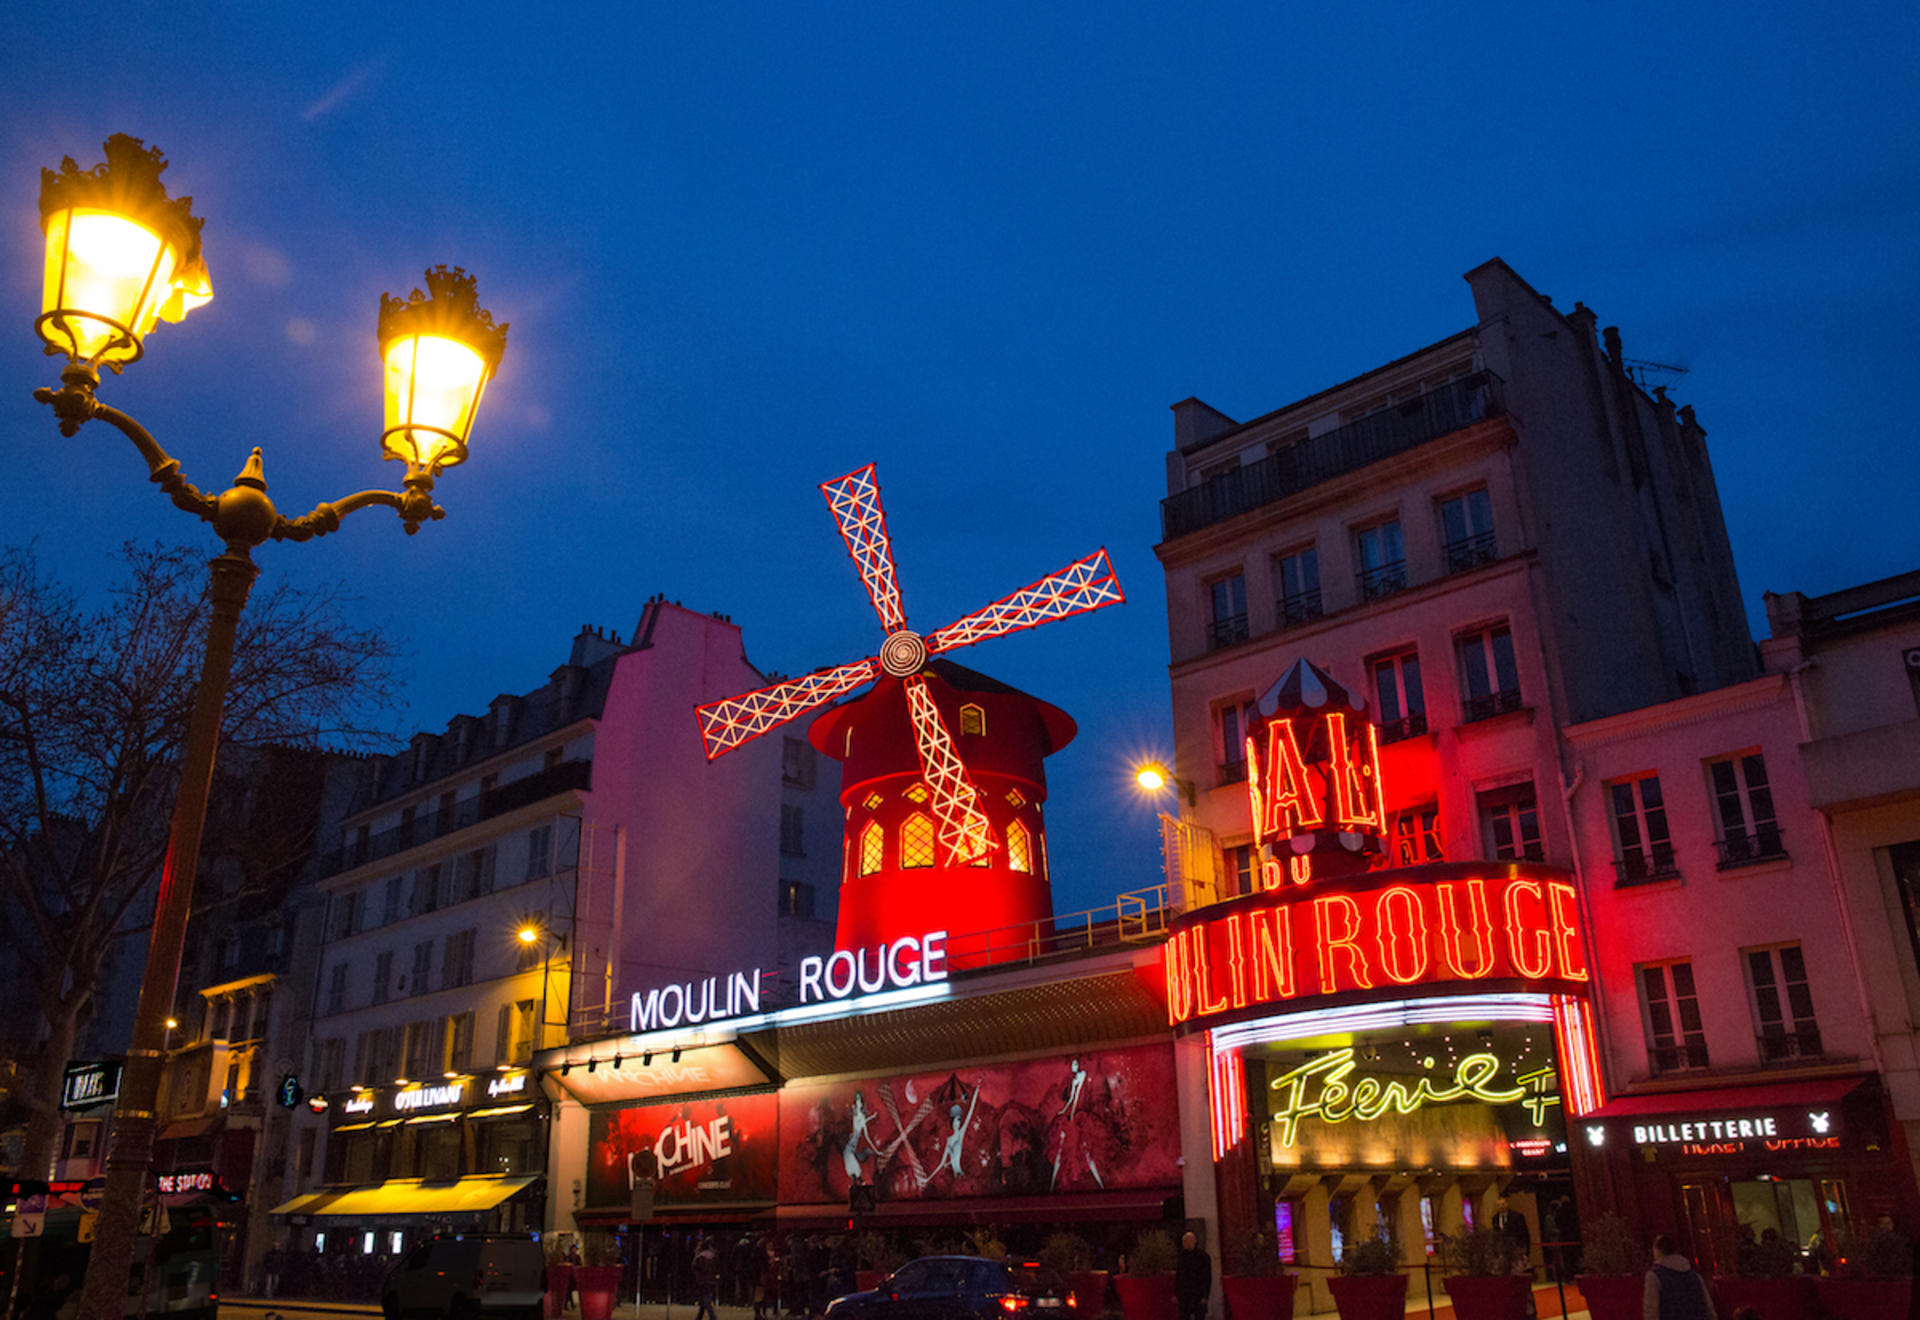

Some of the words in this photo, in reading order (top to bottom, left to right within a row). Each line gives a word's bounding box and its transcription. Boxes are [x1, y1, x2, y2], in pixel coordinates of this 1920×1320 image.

[1261, 853, 1311, 891] DU
[1313, 877, 1590, 996] ROUGE
[629, 967, 762, 1033] MOULIN
[797, 930, 950, 1003] ROUGE
[1630, 1117, 1778, 1145] BILLETTERIE
